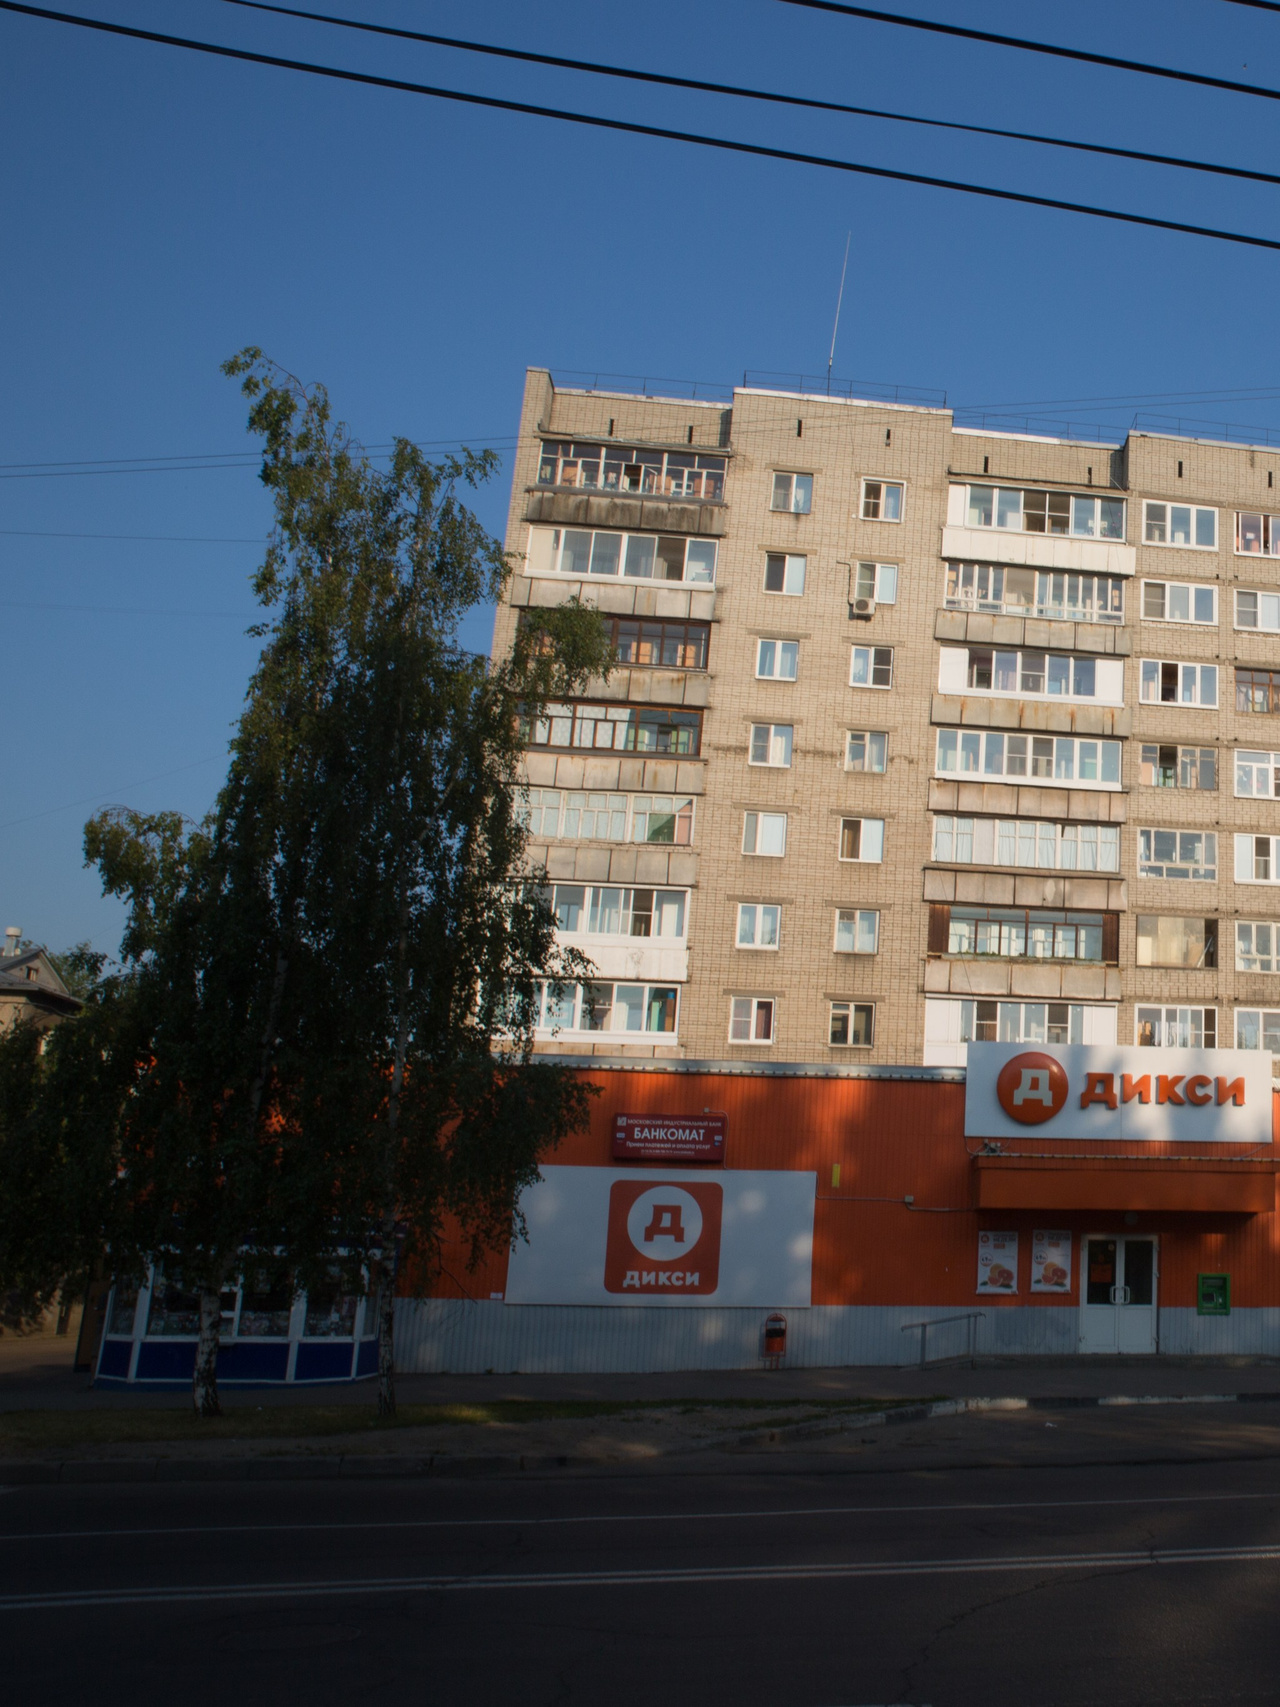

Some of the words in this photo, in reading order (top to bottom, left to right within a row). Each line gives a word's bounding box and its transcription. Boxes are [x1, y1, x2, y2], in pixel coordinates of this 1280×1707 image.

[1080, 1072, 1246, 1110] ДИКСИ
[634, 1127, 705, 1141] БАНКОМАТ
[622, 1270, 700, 1288] ДИКСИ
